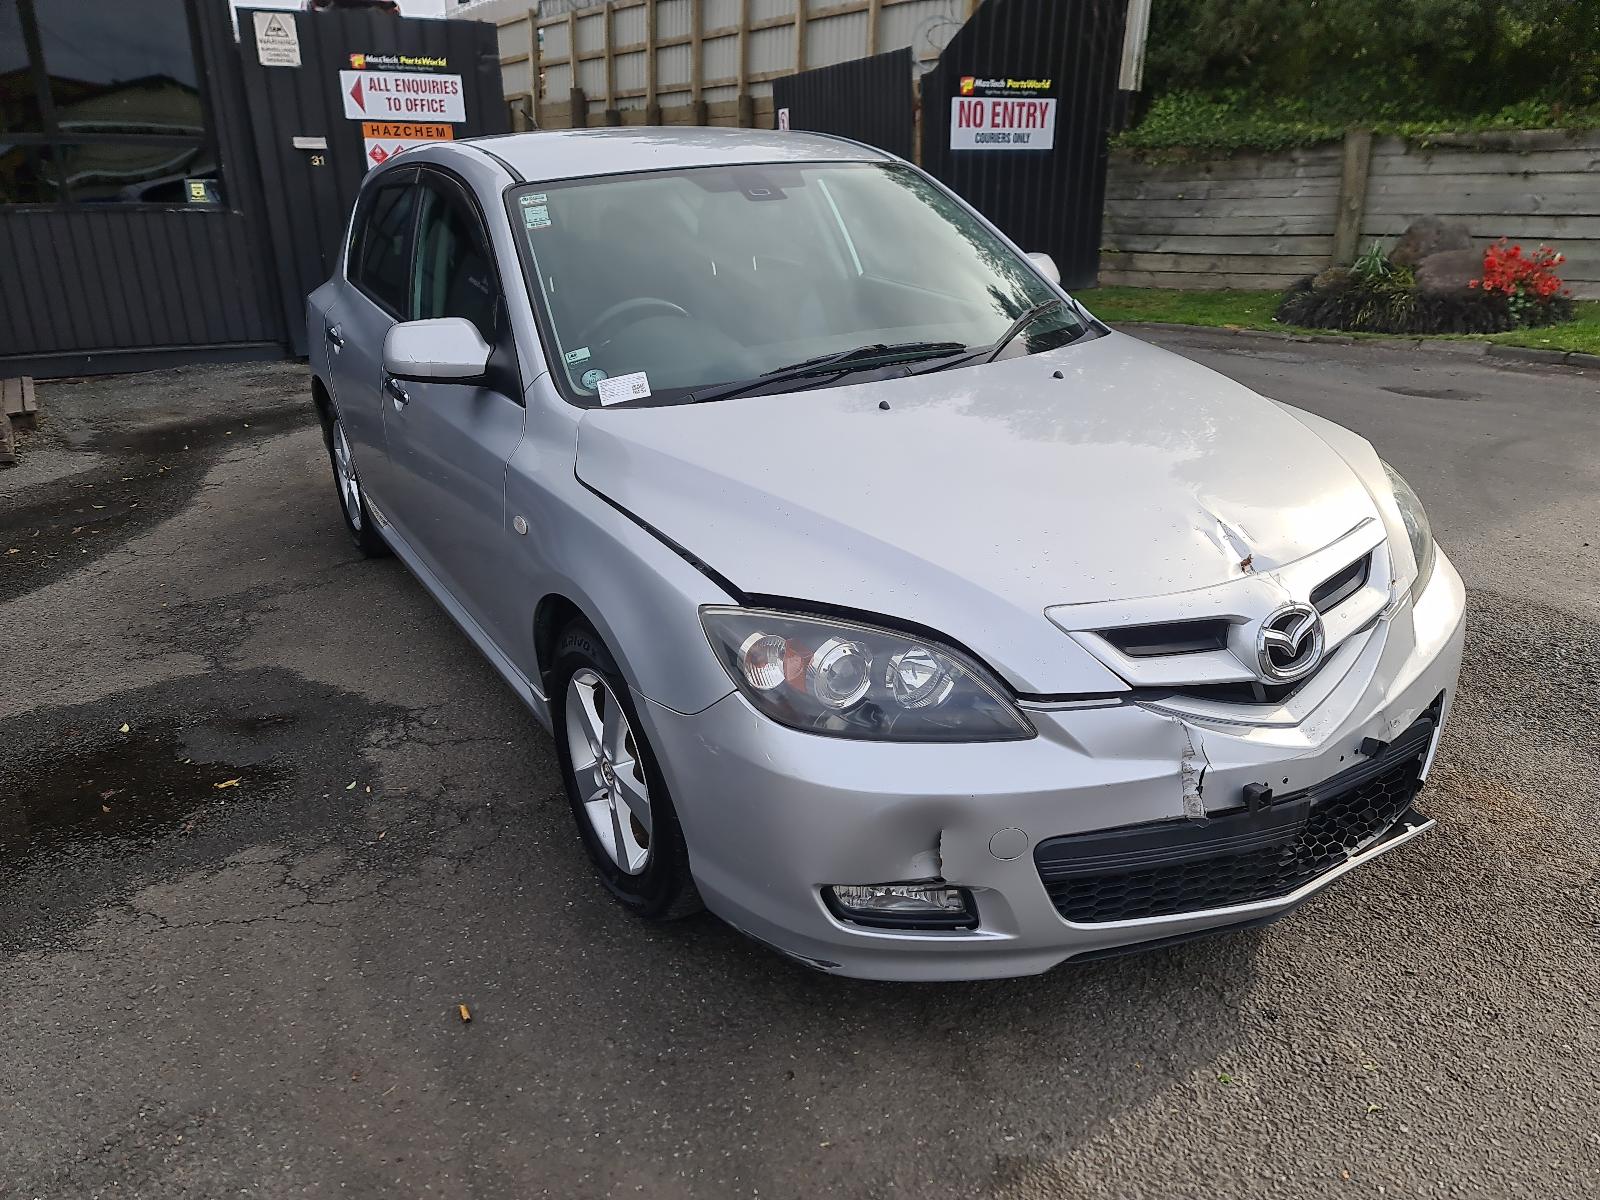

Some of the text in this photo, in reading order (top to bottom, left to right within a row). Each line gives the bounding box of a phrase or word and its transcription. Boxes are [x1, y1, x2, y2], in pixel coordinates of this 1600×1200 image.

[400, 56, 447, 66] PartsWorld
[369, 78, 458, 95] ALL ENQUIRIES
[1007, 79, 1050, 88] PartsWorld
[386, 97, 446, 113] TO OFFICE
[959, 101, 1048, 128] NO ENTRY
[371, 126, 446, 137] HAZCHEM
[975, 133, 1031, 143] COURIERS ONLY
[311, 155, 325, 166] 31
